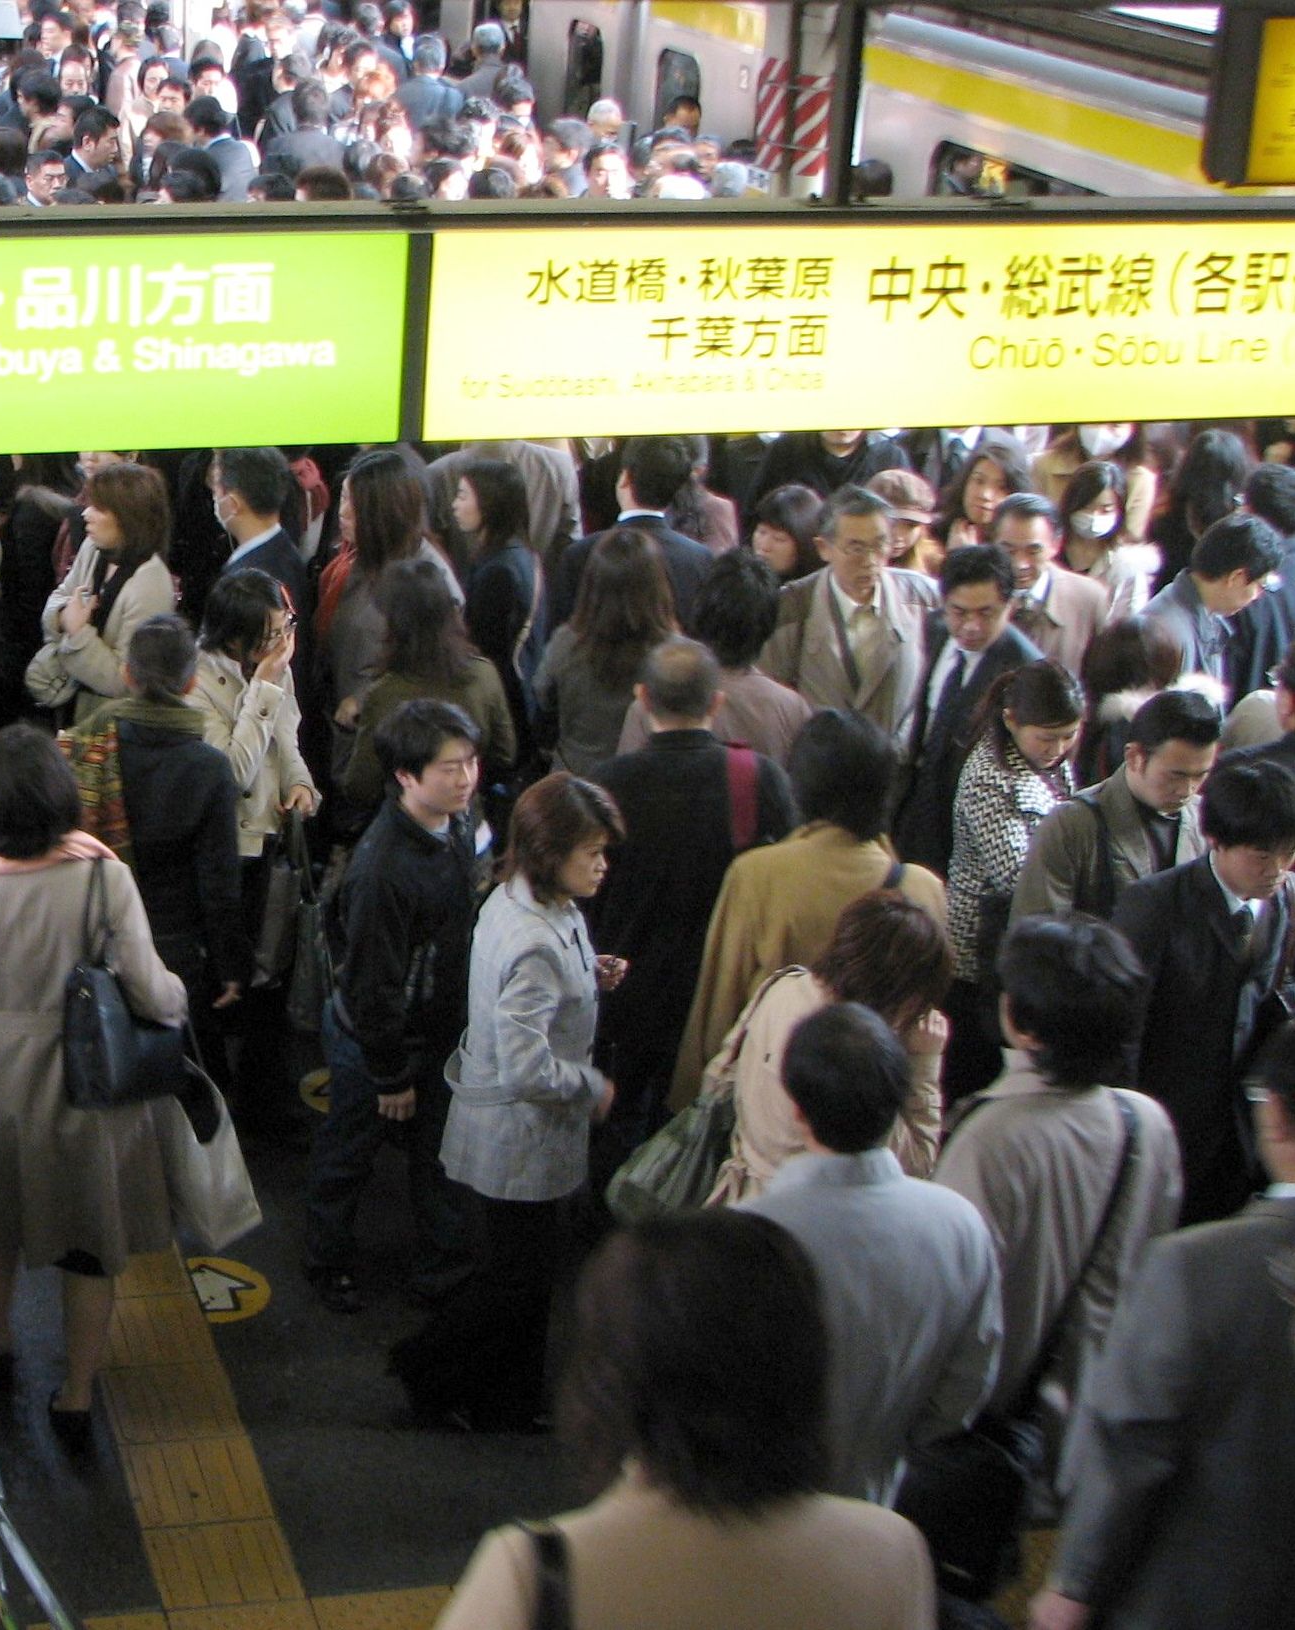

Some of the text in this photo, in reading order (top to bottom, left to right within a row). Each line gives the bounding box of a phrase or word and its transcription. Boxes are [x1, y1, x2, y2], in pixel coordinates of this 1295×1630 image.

[526, 256, 835, 305] 水道橋・秋葉原
[93, 339, 122, 374] &
[132, 336, 337, 376] Shinagawa
[648, 314, 828, 361] 千葉方面
[1197, 332, 1269, 364] Line
